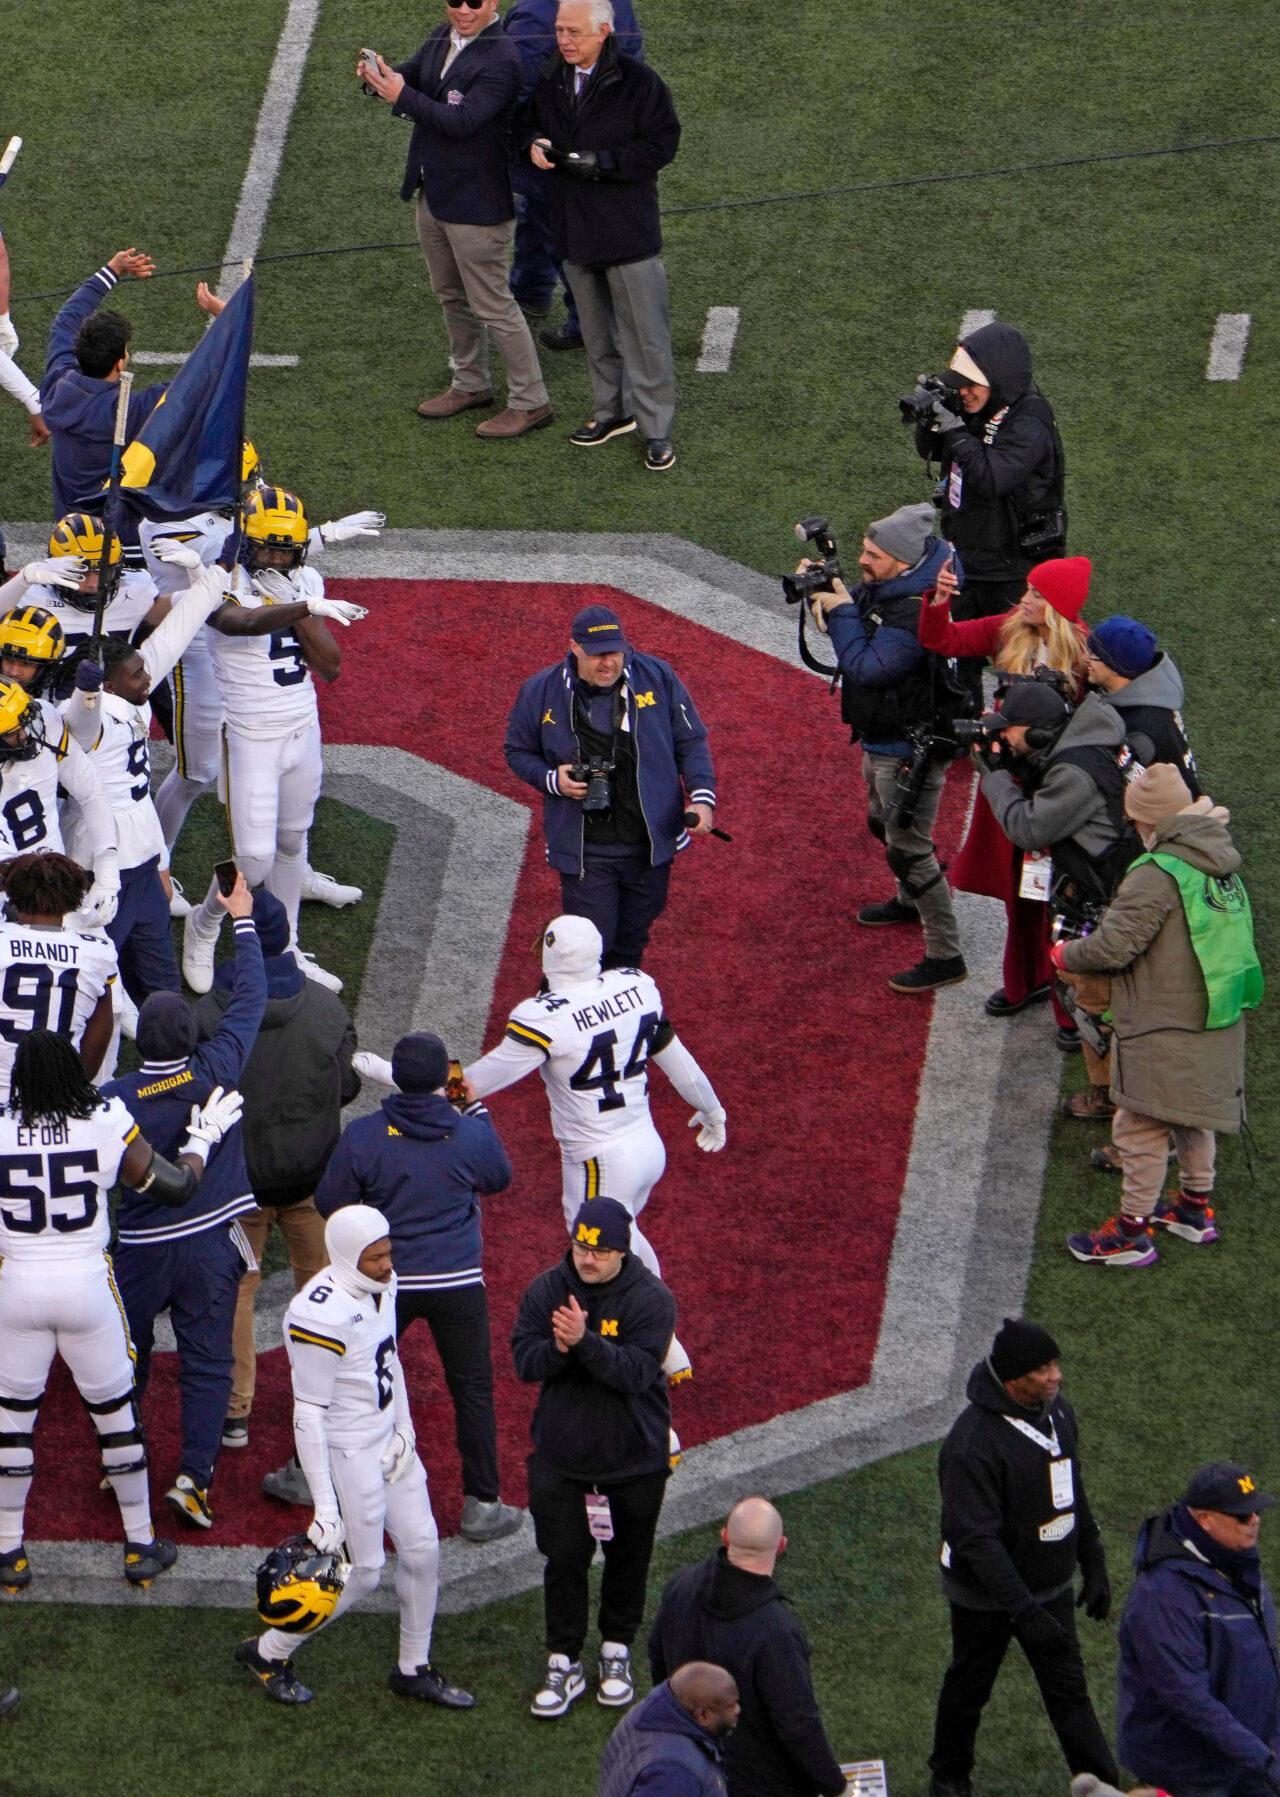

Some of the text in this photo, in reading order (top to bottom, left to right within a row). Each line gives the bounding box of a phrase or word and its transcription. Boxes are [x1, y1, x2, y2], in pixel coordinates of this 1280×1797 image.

[269, 628, 308, 687] 5
[635, 691, 657, 709] M
[2, 789, 45, 851] 8
[9, 939, 80, 965] BRANDT
[0, 962, 80, 1045] 91
[572, 986, 644, 1031] HEWLETT
[137, 1070, 194, 1098] MICHIGAN
[17, 1124, 71, 1146] EFOBI
[576, 1223, 601, 1246] M
[308, 1285, 334, 1304] 6
[601, 1319, 619, 1336] M
[375, 1334, 397, 1412] 6
